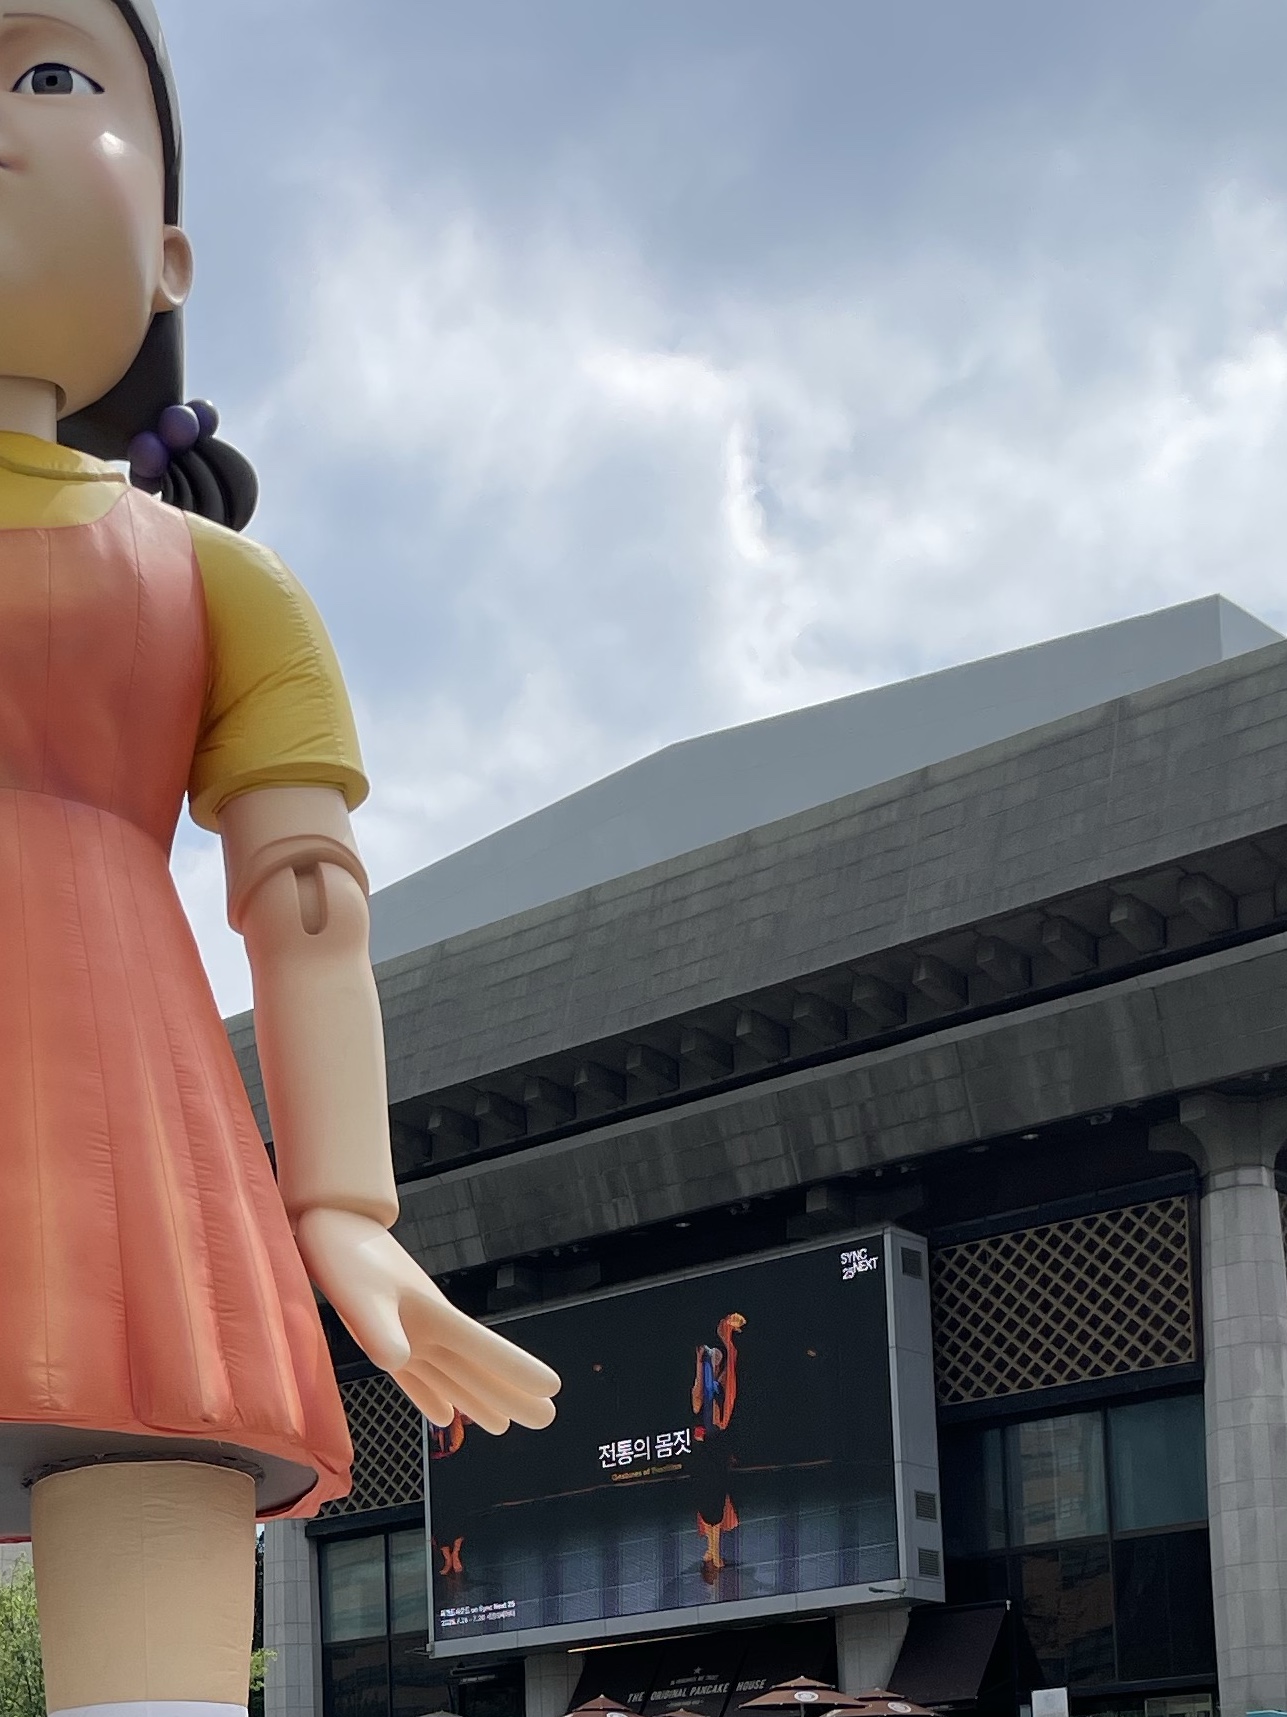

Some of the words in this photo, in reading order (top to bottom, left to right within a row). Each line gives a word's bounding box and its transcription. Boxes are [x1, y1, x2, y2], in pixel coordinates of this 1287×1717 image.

[841, 1248, 867, 1265] SYNC
[853, 1256, 879, 1273] NEXT
[598, 1436, 650, 1468] 전통의
[655, 1428, 692, 1459] 몸짓
[627, 1691, 645, 1703] THE
[650, 1687, 687, 1701] ORIGINAL
[689, 1682, 731, 1697] PANCAKE
[735, 1679, 767, 1692] HOUSE
